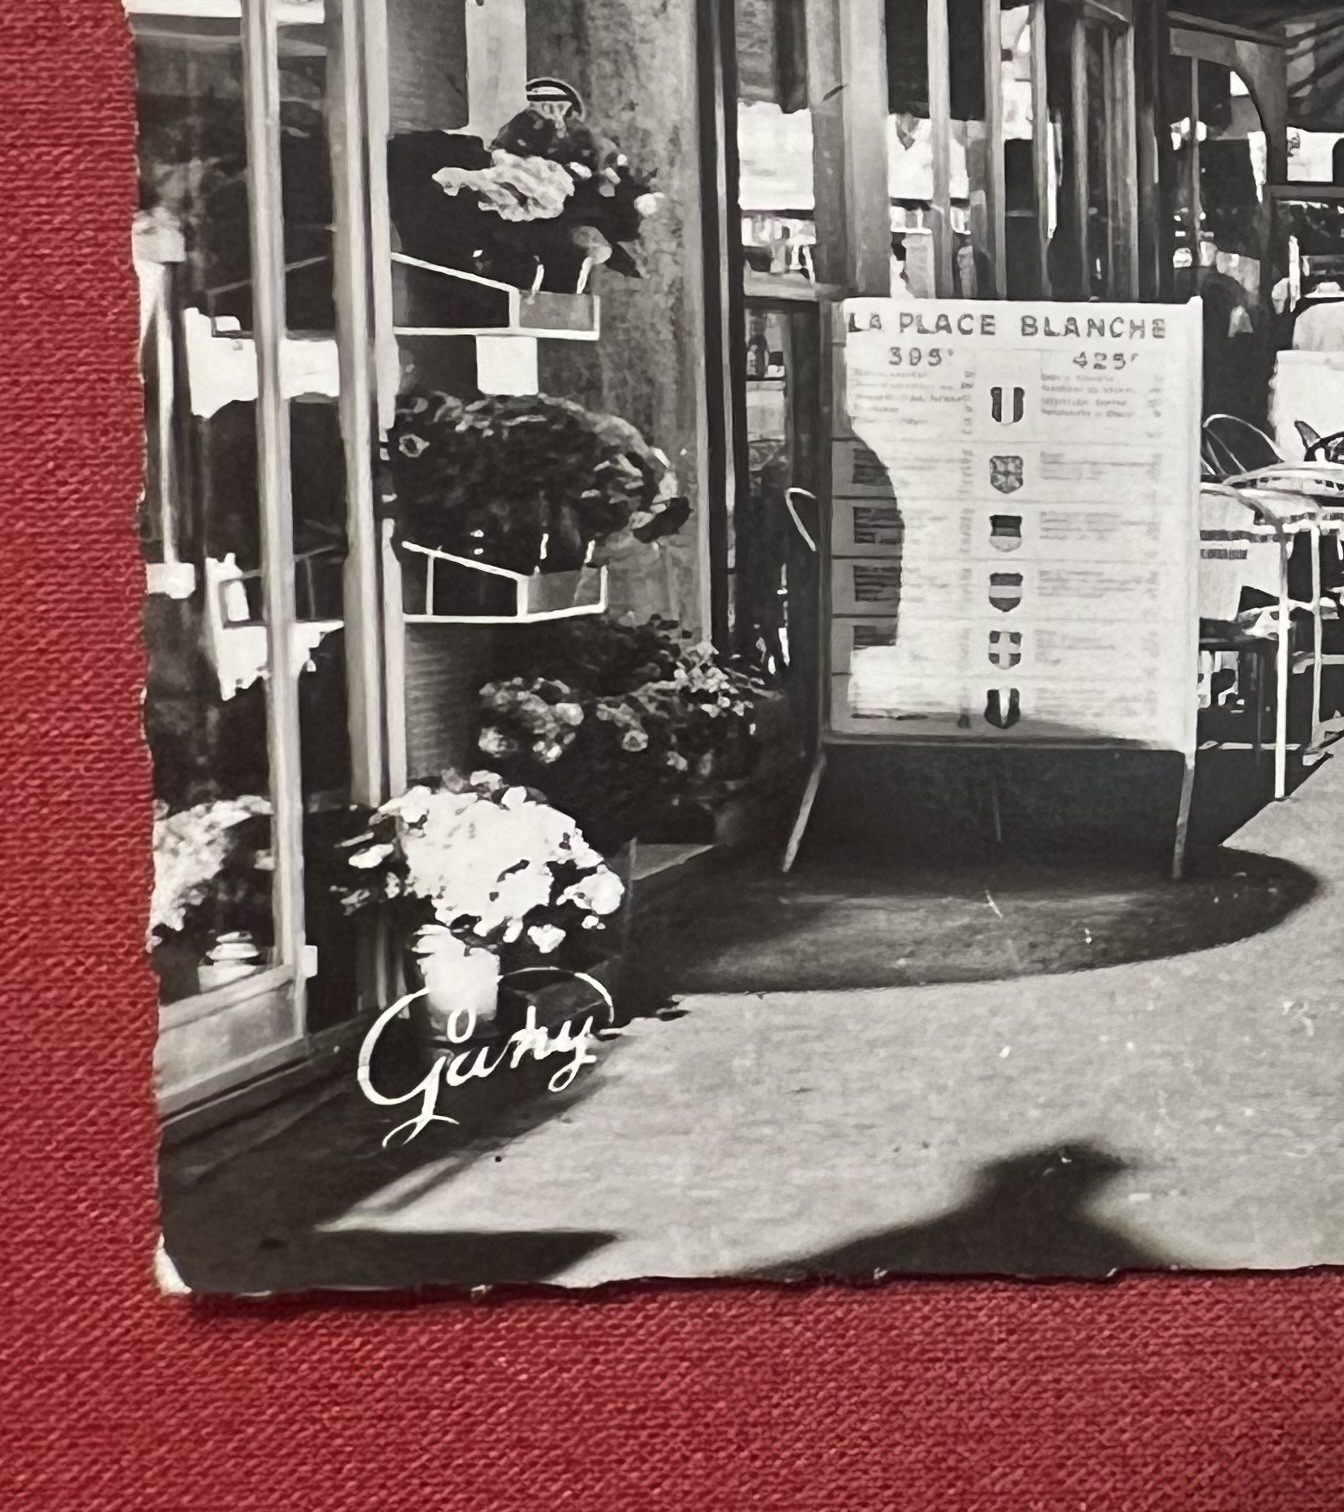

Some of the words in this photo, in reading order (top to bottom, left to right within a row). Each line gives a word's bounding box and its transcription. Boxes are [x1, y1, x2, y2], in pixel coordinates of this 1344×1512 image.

[848, 312, 883, 334] LA
[899, 313, 997, 337] PLACE
[1021, 315, 1167, 341] BLANCHE
